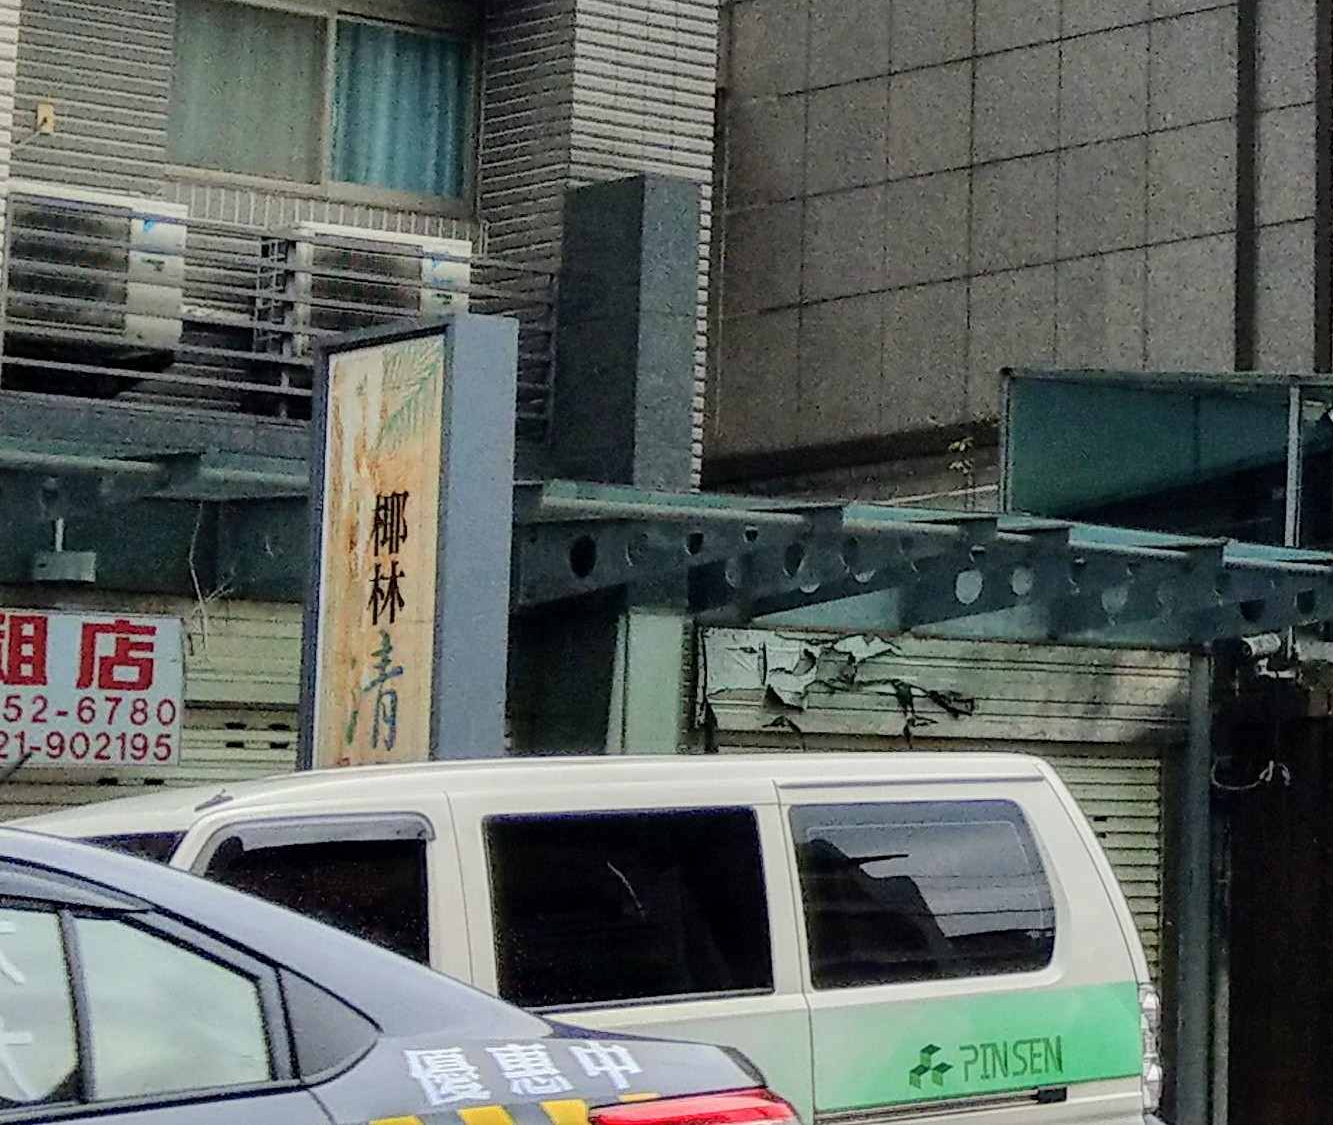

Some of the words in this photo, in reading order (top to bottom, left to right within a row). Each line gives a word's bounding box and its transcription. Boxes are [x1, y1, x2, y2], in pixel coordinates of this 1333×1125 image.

[402, 1040, 643, 1106] 優惠中
[958, 1034, 1064, 1083] PINSEN
